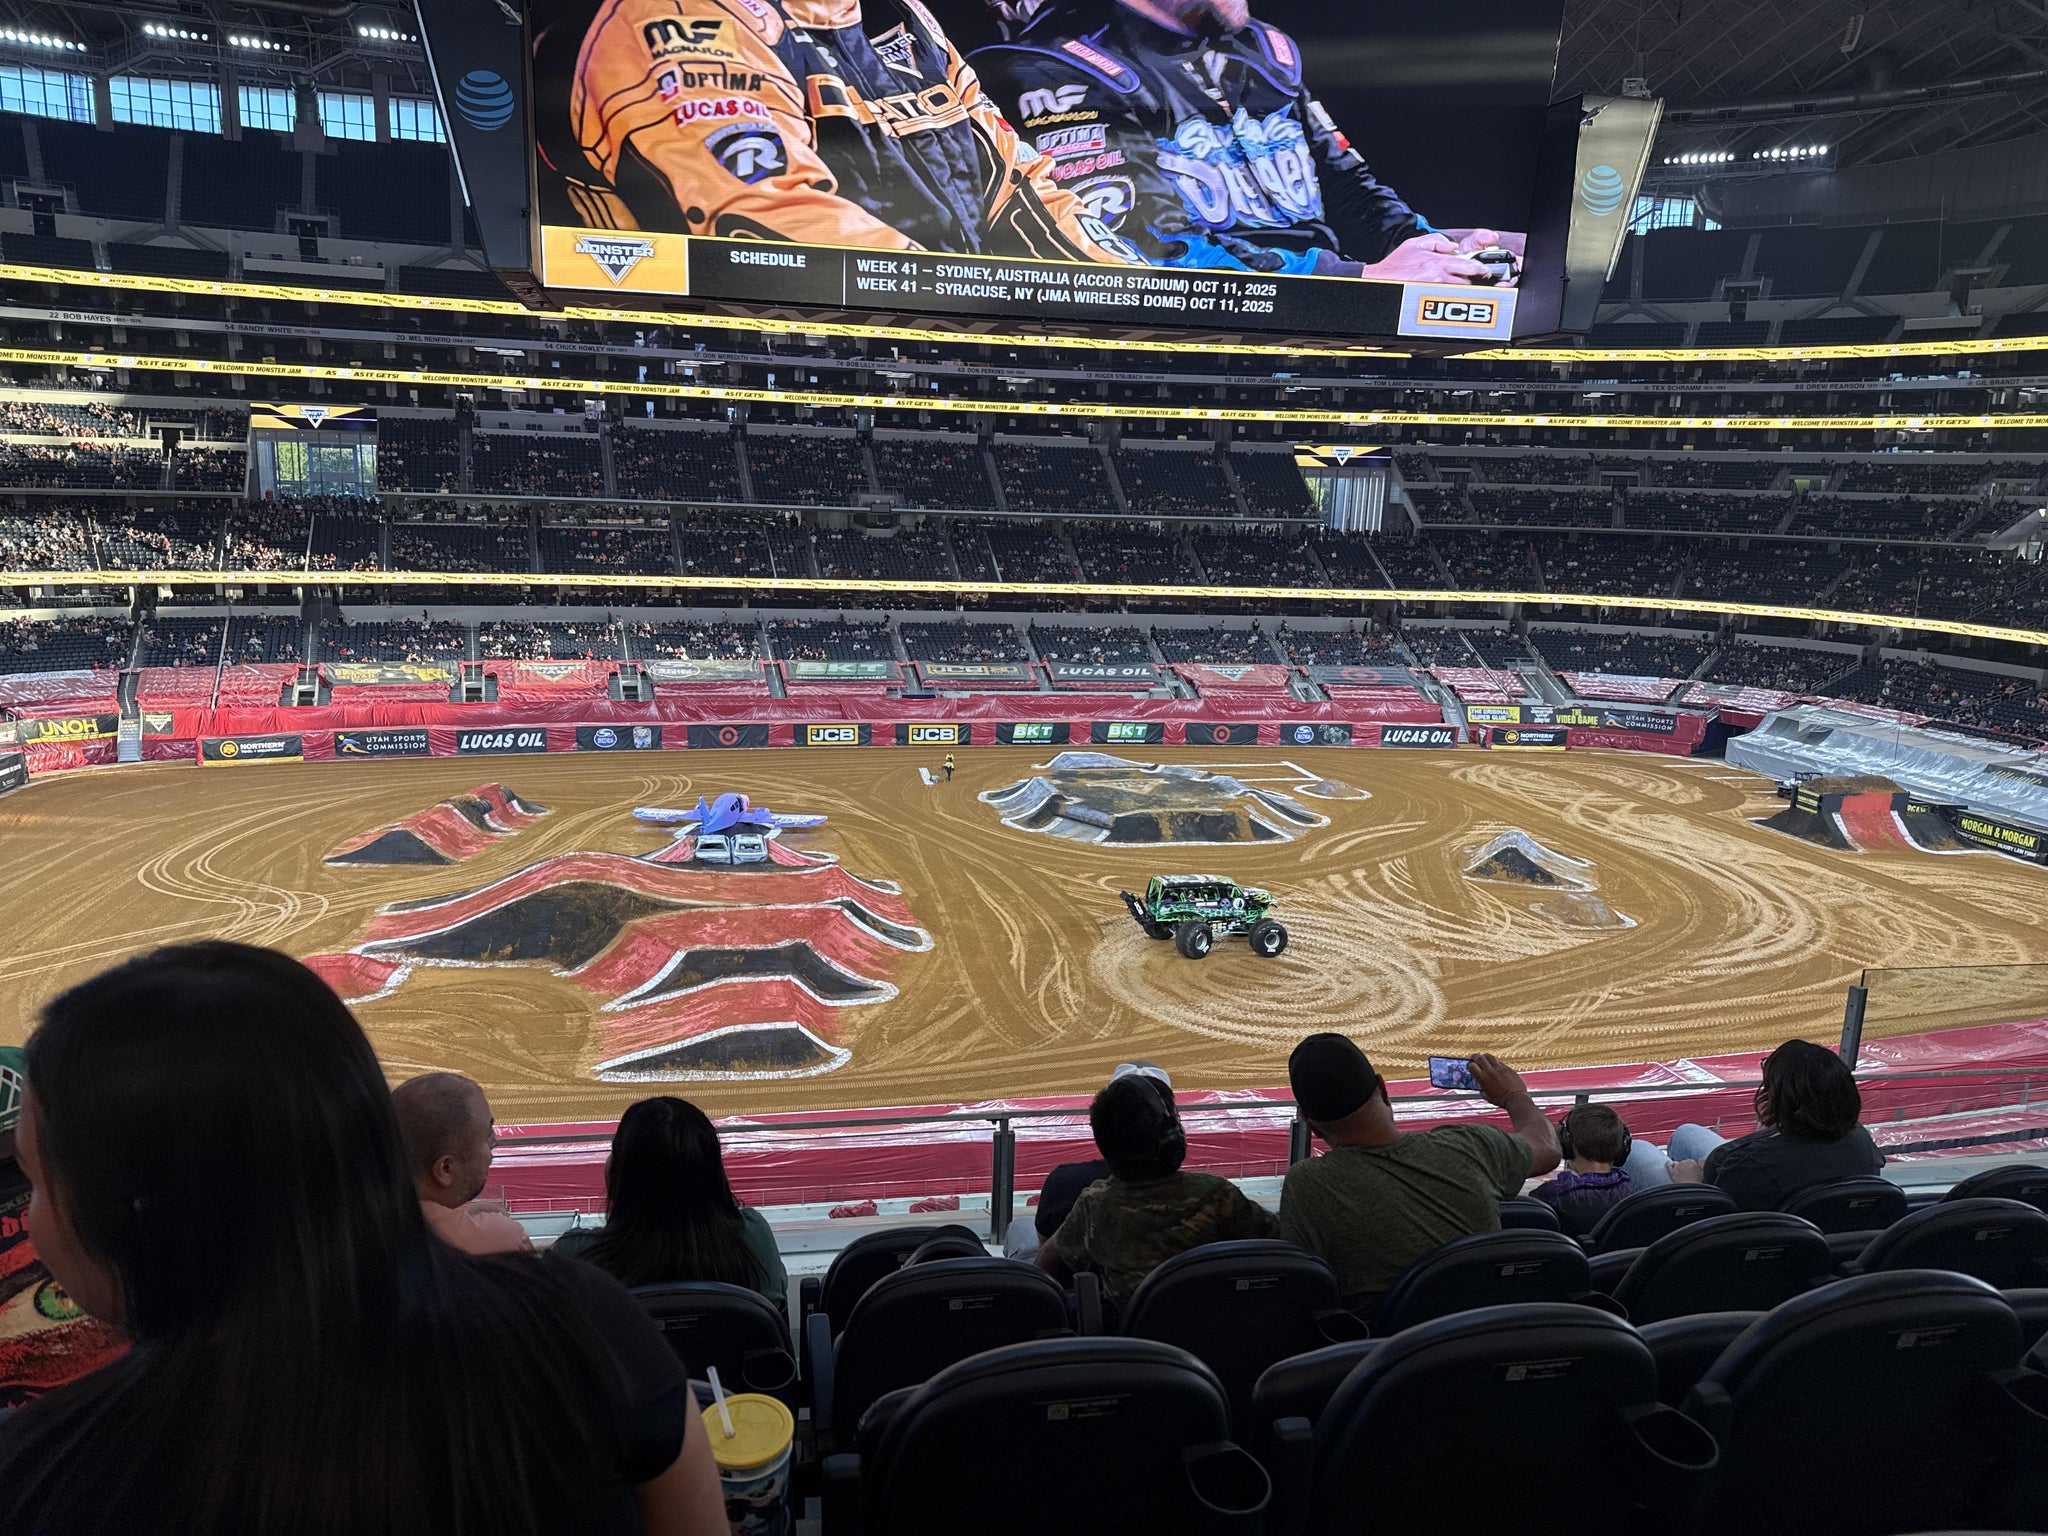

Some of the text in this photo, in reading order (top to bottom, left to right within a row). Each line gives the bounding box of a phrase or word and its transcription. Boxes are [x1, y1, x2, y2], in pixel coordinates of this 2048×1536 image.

[683, 72, 762, 91] OPTIMA
[674, 100, 770, 126] LUCAS OIL
[1052, 157, 1096, 181] UCAS
[575, 243, 655, 258] MONSTER
[597, 255, 635, 266] JAM
[729, 250, 806, 269] SCHEDULE
[857, 259, 897, 275] WEEK
[901, 263, 917, 276] 41
[936, 265, 993, 282] SYDNEY,
[995, 268, 1070, 285] AUSTRALIA
[1073, 273, 1123, 289] (ACCOR
[1127, 277, 1189, 294] STADIUM)
[1193, 280, 1219, 294] OCT
[1222, 282, 1241, 296] 11,
[1245, 283, 1277, 297] 2025
[857, 277, 897, 292] WEEK
[901, 280, 917, 293] 41
[935, 282, 1011, 301] SYRACUSE,
[1014, 287, 1034, 300] NY
[1037, 288, 1070, 304] (JMA
[1074, 291, 1140, 306] WIRELESS
[1143, 294, 1186, 311] DOME)
[1190, 297, 1216, 310] OCT
[1219, 299, 1239, 314] 11,
[1241, 301, 1274, 314] 2025
[83, 314, 112, 322] HAYES
[1424, 303, 1493, 323] JCB
[238, 324, 265, 332] RANDY
[267, 326, 292, 334] WHITE
[26, 353, 60, 361] MONSTER
[1990, 378, 2020, 386] BRANDT
[798, 663, 885, 673] BKT
[1058, 667, 1151, 676] LUCAS OIL
[1556, 714, 1576, 723] VIDEO
[1577, 715, 1599, 725] GAME
[1625, 721, 1673, 731] COMMISSION
[1647, 717, 1674, 725] SPORTS
[39, 718, 99, 736] UNOH
[1013, 725, 1053, 738] BKT
[1108, 725, 1147, 737] BKT
[366, 734, 426, 743] UTAH SPORTS
[460, 733, 546, 749] LUCAS OIL
[811, 729, 856, 742] JCB
[912, 728, 956, 741] JCB
[1383, 730, 1453, 743] LUCAS OIL
[240, 742, 286, 750] NORTHERN
[366, 742, 427, 751] COMMISSION
[1961, 817, 2037, 848] MORGAN & MORGAN
